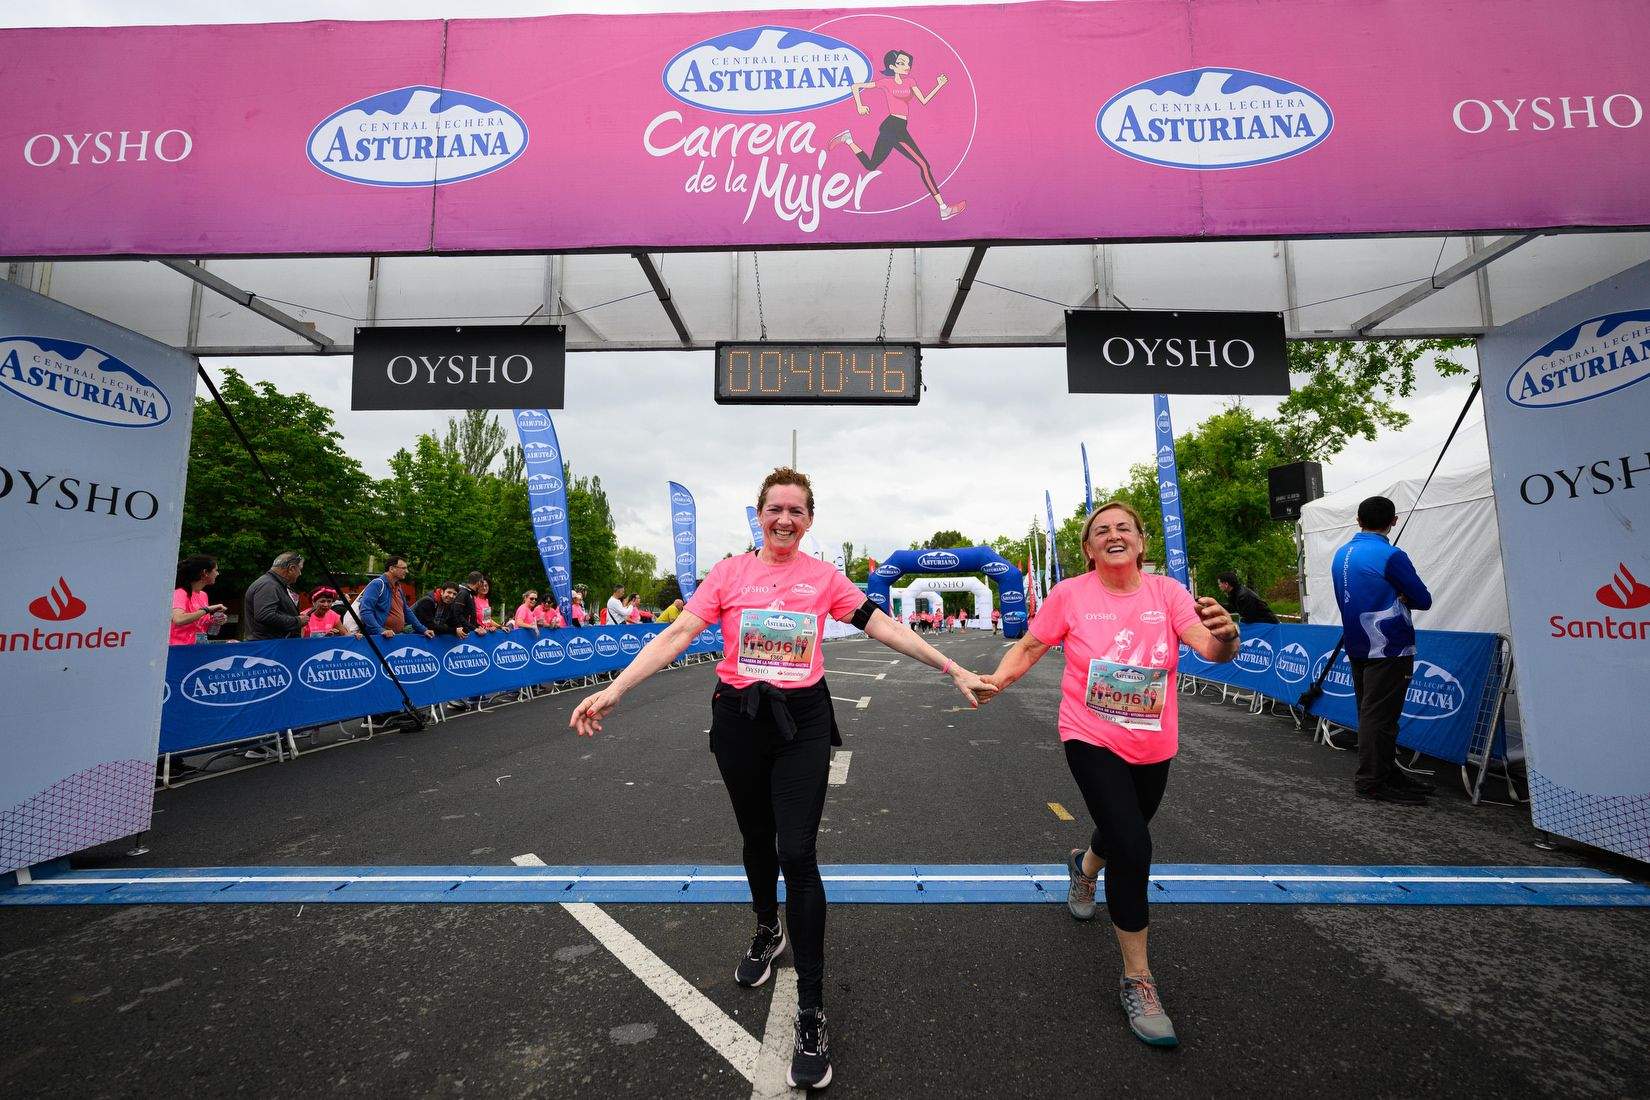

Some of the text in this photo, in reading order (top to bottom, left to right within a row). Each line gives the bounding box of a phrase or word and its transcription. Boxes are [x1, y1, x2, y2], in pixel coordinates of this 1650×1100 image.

[711, 53, 850, 66] CENTRAL LECHERA
[678, 59, 856, 93] ASTURIANA
[1149, 98, 1306, 113] CENTRAL LECHERA
[1452, 93, 1644, 134] OYSHO
[359, 117, 505, 132] CENTRAL LECHERA
[643, 110, 817, 158] Carrera
[1115, 104, 1316, 143] ASTURIANA
[23, 129, 194, 167] OYSHO
[322, 126, 511, 163] ASTURIANA
[684, 149, 883, 233] de la Mujer
[1102, 336, 1256, 369] OYSHO
[1541, 346, 1598, 371] CENTRAL
[33, 355, 157, 400] CENTRAL LECHERA
[386, 354, 534, 386] OYSHO
[728, 351, 906, 393] 00:40:46
[0, 348, 159, 421] ASTURIANA
[921, 556, 957, 566] ASTURIANA
[928, 581, 964, 589] OYSHO
[496, 652, 528, 665] ASTURIANA
[765, 640, 793, 653] 016
[306, 665, 373, 684] ASTURIANA
[448, 656, 488, 670] ASTURIANA
[192, 674, 287, 698] ASTURIANA
[1112, 691, 1142, 705] 016
